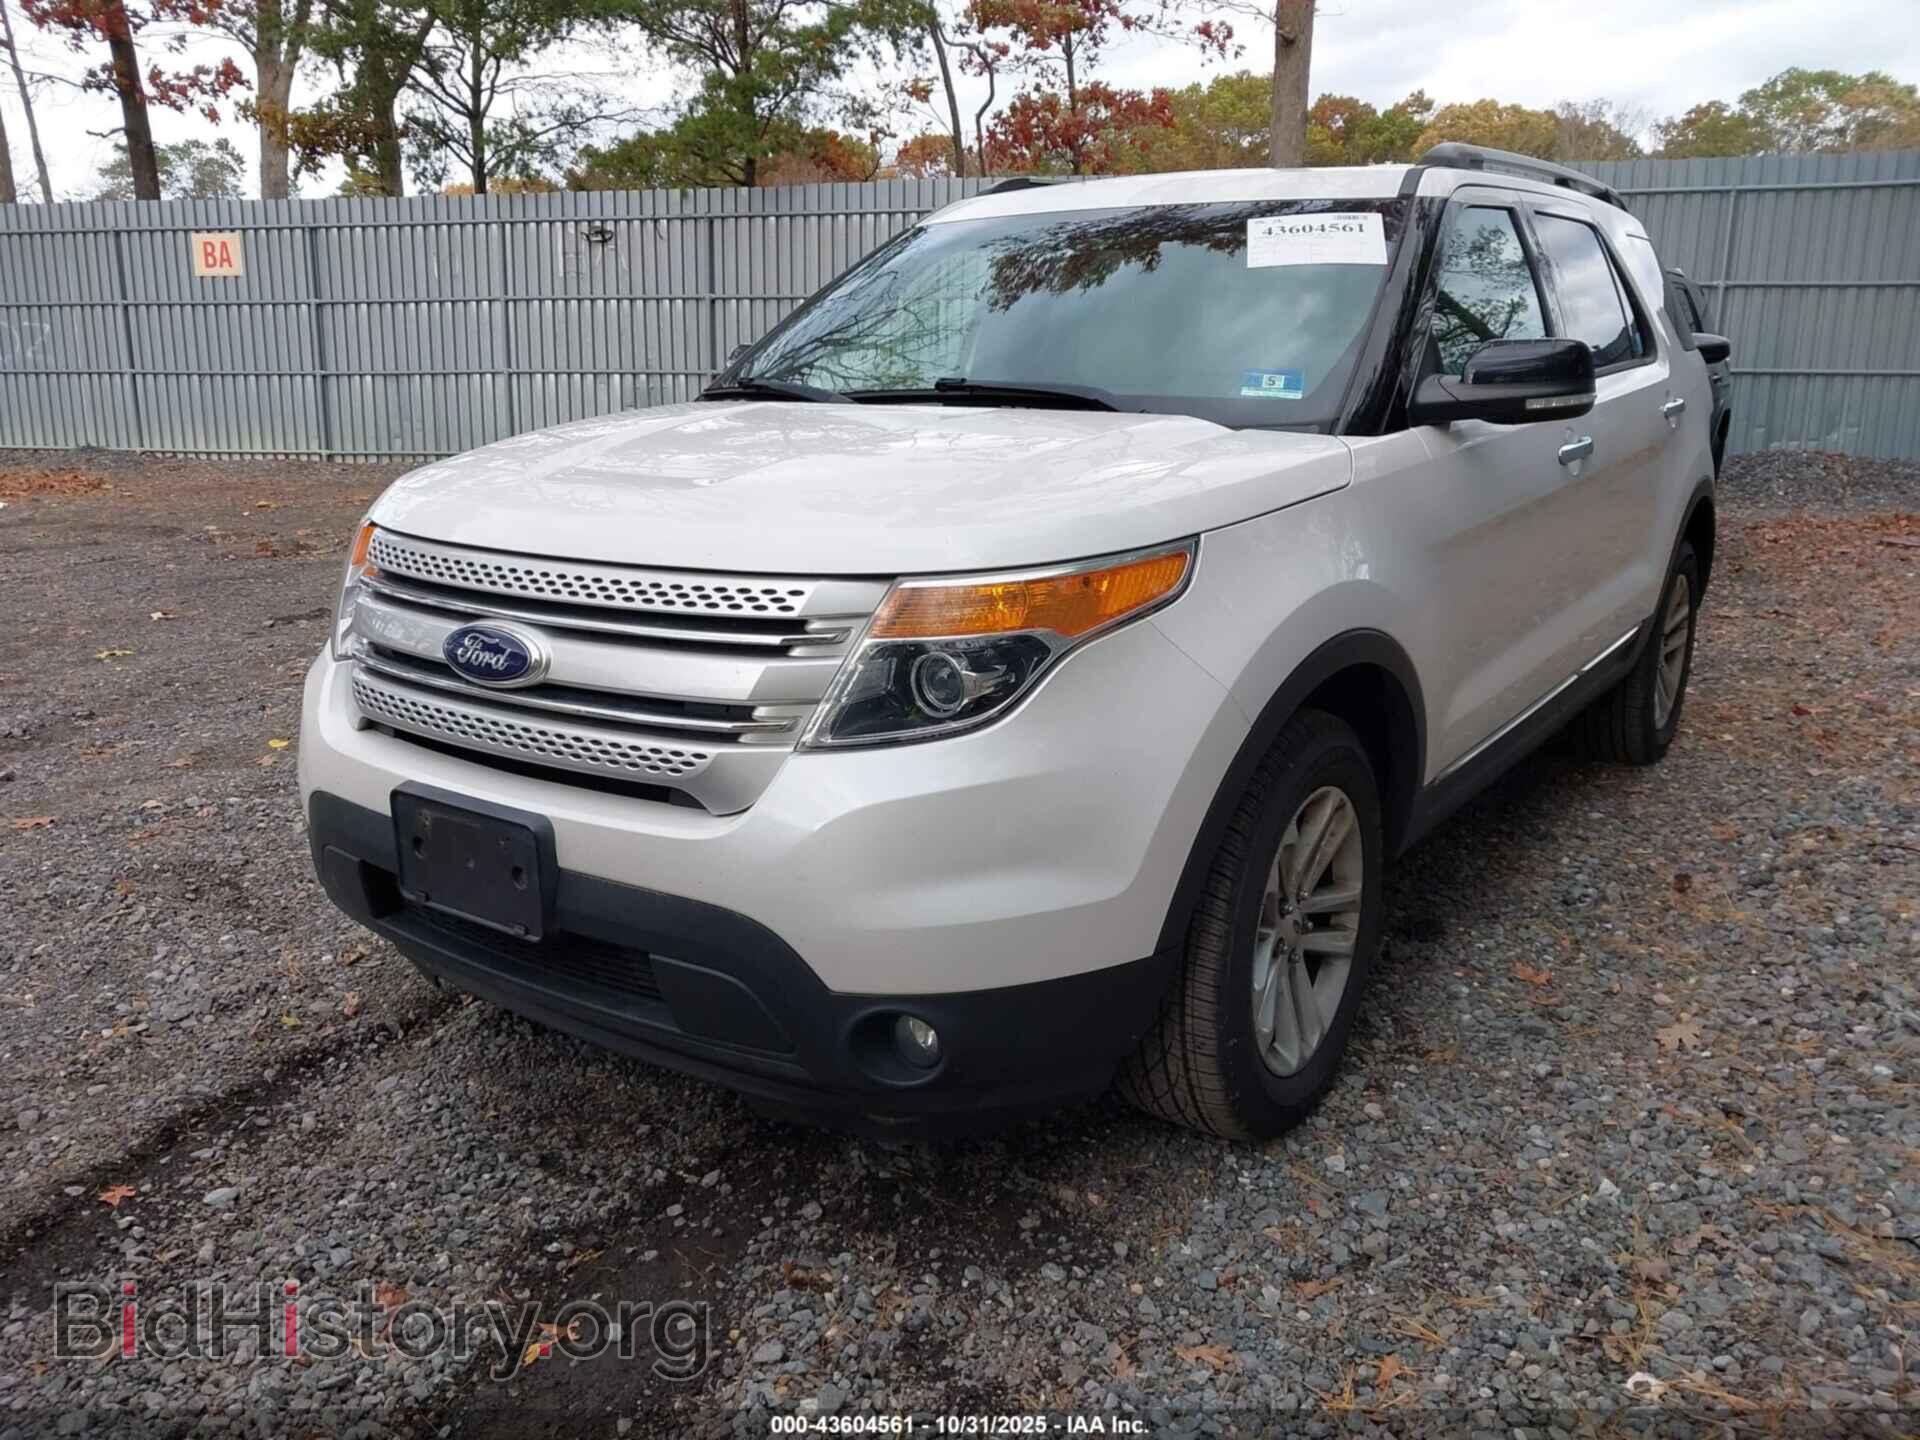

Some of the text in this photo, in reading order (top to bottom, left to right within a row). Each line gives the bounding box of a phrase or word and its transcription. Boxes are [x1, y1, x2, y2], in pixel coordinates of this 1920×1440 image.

[1262, 223, 1366, 236] 43604561
[203, 241, 233, 268] BA
[457, 632, 512, 671] Ford
